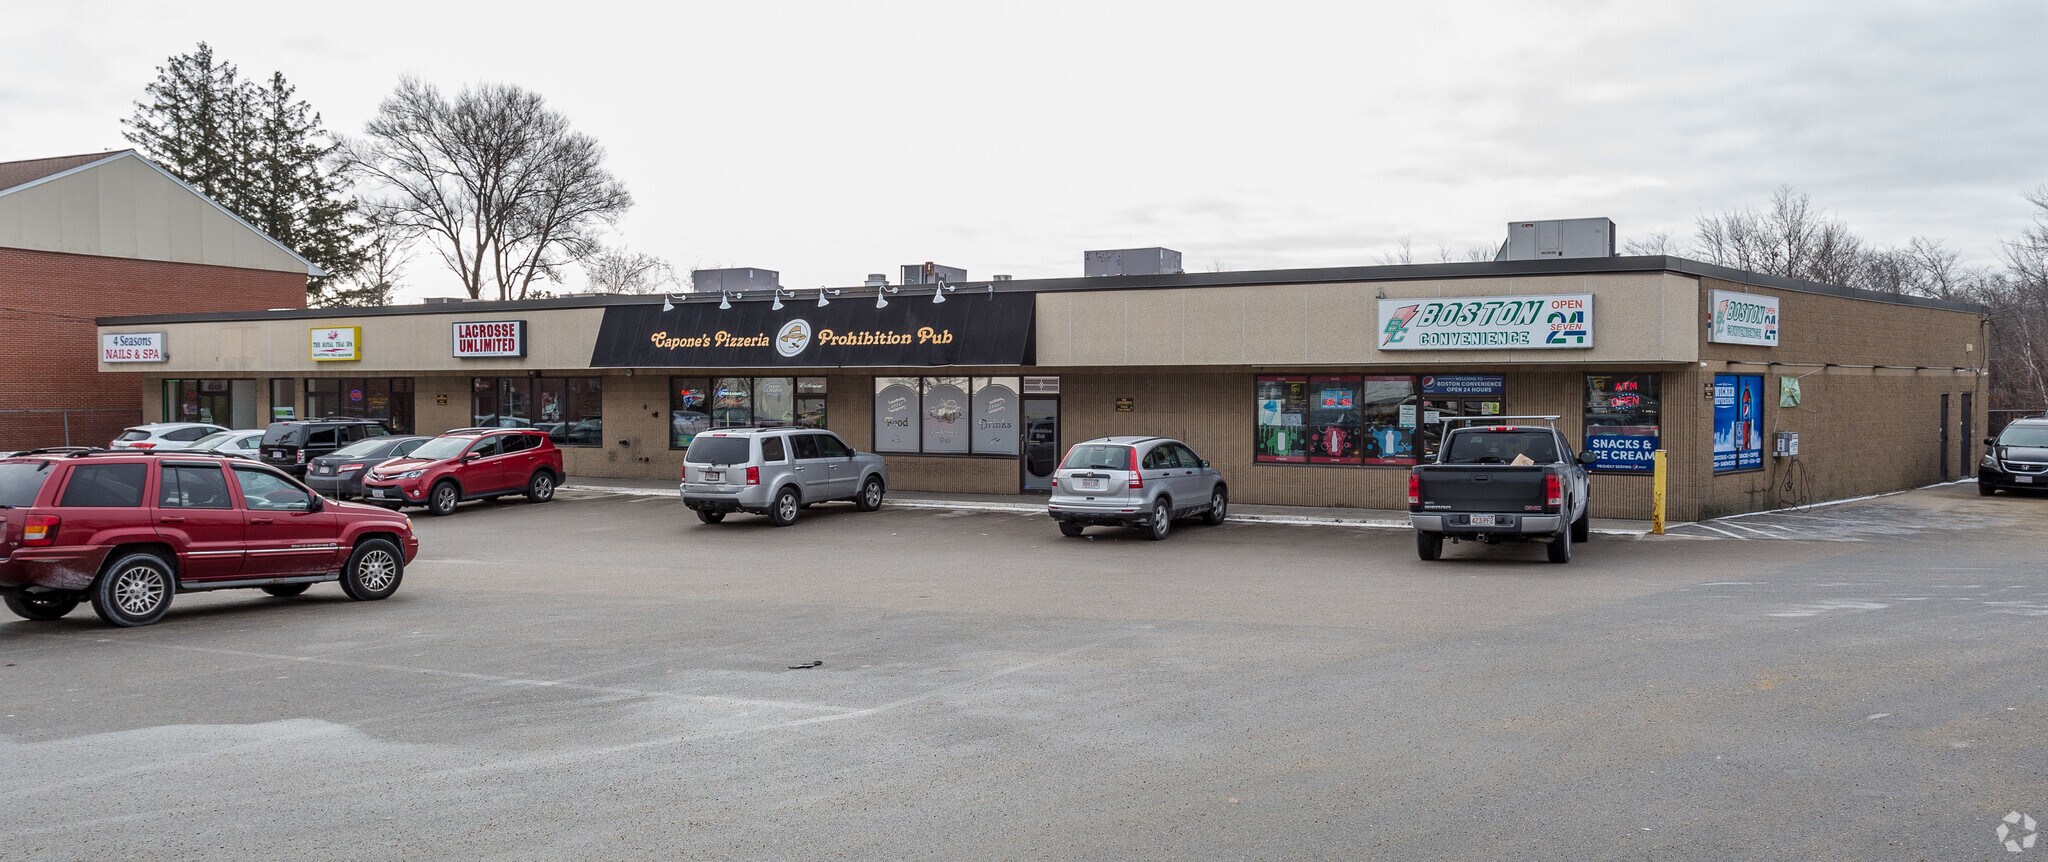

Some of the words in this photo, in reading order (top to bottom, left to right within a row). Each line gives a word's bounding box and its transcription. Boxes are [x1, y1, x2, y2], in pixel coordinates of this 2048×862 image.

[1551, 300, 1583, 310] OPEN
[1416, 300, 1545, 328] BOSTON
[1727, 301, 1766, 324] BOSTON
[459, 323, 515, 338] LACROSSE
[1550, 323, 1582, 331] SEVEN
[1727, 325, 1762, 340] CONVENIENCE
[113, 336, 118, 346] 4
[120, 335, 152, 346] Seasons
[651, 331, 711, 350] Capone's
[714, 330, 770, 347] Pizzeria
[818, 328, 912, 346] Prohibition
[917, 326, 953, 344] Pub
[1419, 331, 1530, 346] CONVENIENCE
[459, 338, 515, 352] UNLIMITED
[105, 349, 132, 359] NAILS
[134, 349, 141, 359] &
[142, 348, 160, 359] SPA
[1614, 381, 1638, 391] ATM
[1610, 396, 1640, 407] OPEN
[978, 418, 1012, 430] Drinks
[1592, 439, 1640, 449] SNACKS
[1642, 440, 1652, 449] &
[1589, 450, 1608, 460] CE
[1610, 450, 1655, 460] CREAM
